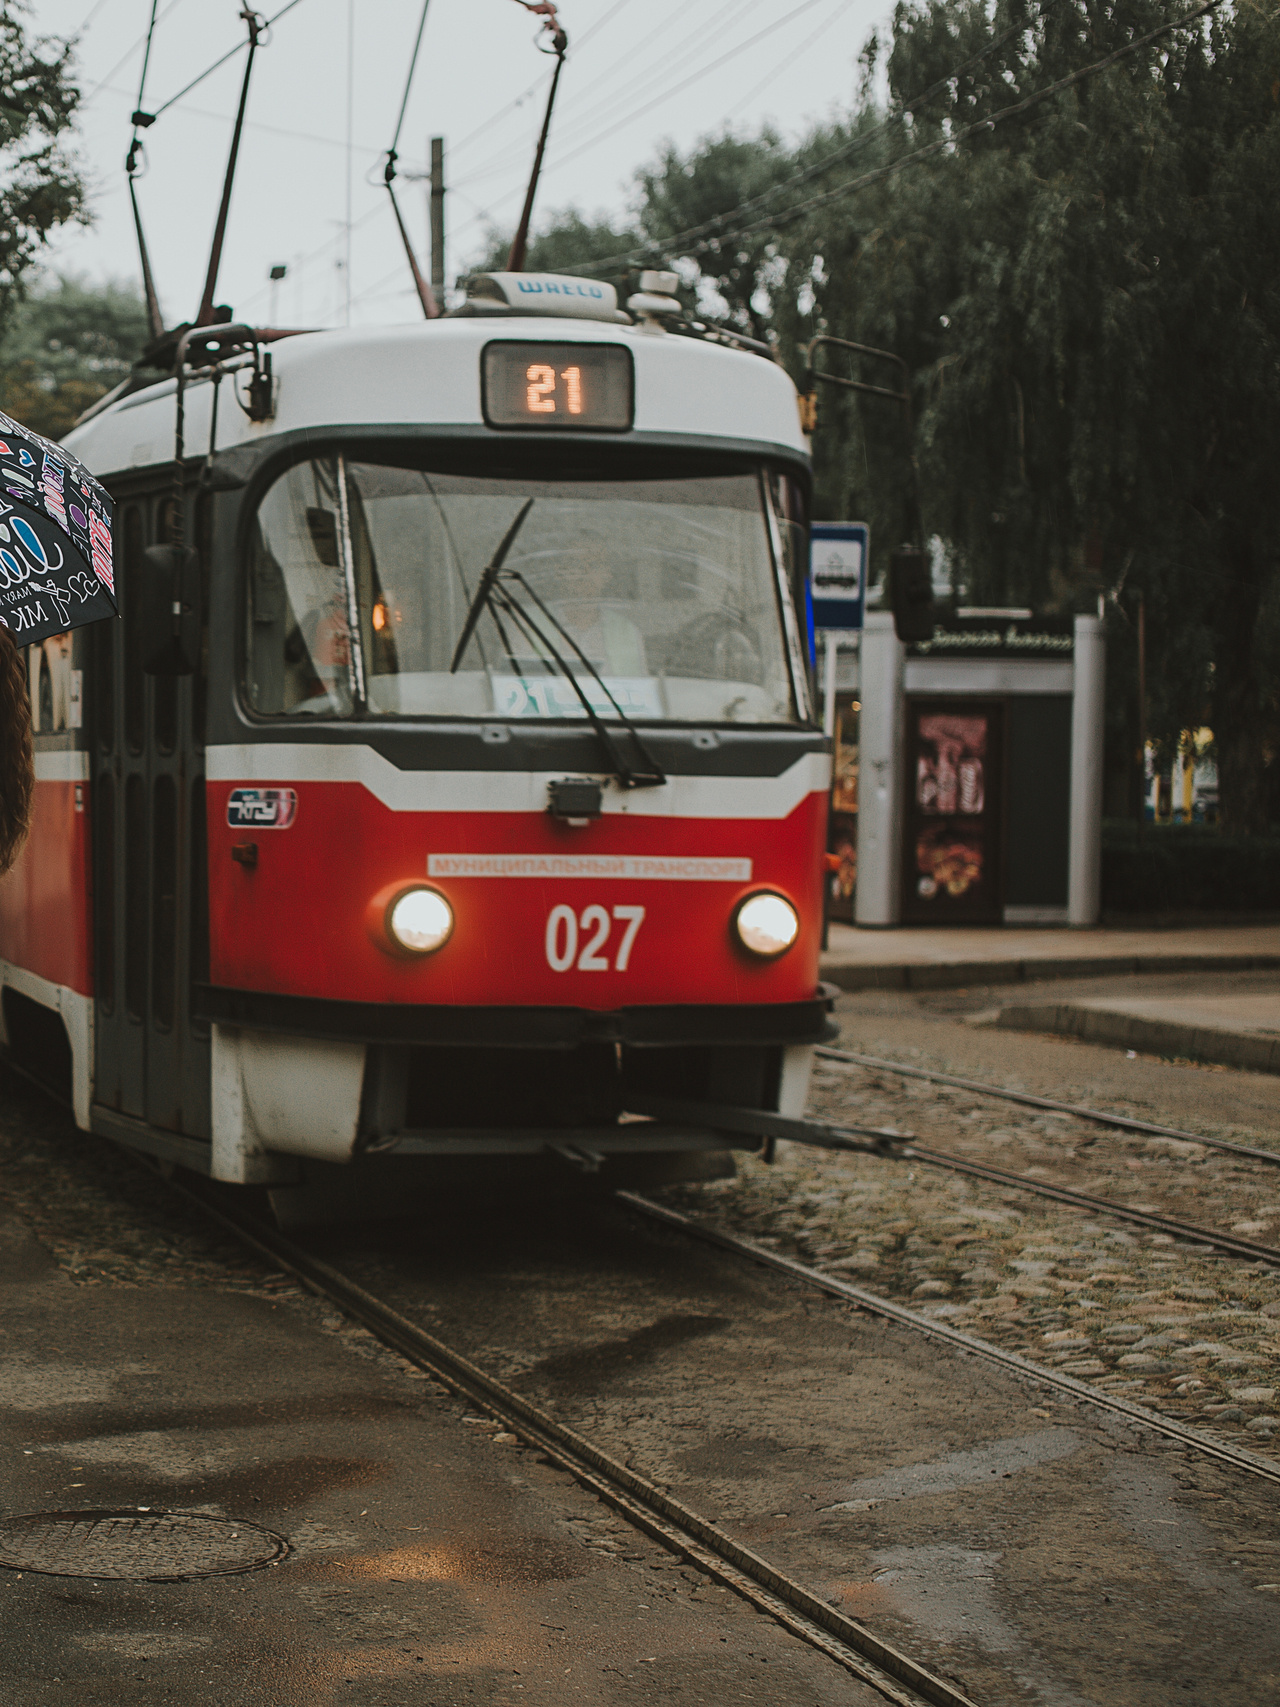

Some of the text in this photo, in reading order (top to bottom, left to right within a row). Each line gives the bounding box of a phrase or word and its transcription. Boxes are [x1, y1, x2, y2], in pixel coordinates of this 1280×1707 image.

[526, 364, 581, 414] 21
[434, 857, 746, 878] МУНИЦИПАЛЬНЫЙ ТРАНСПОРТ
[545, 904, 646, 972] 027
